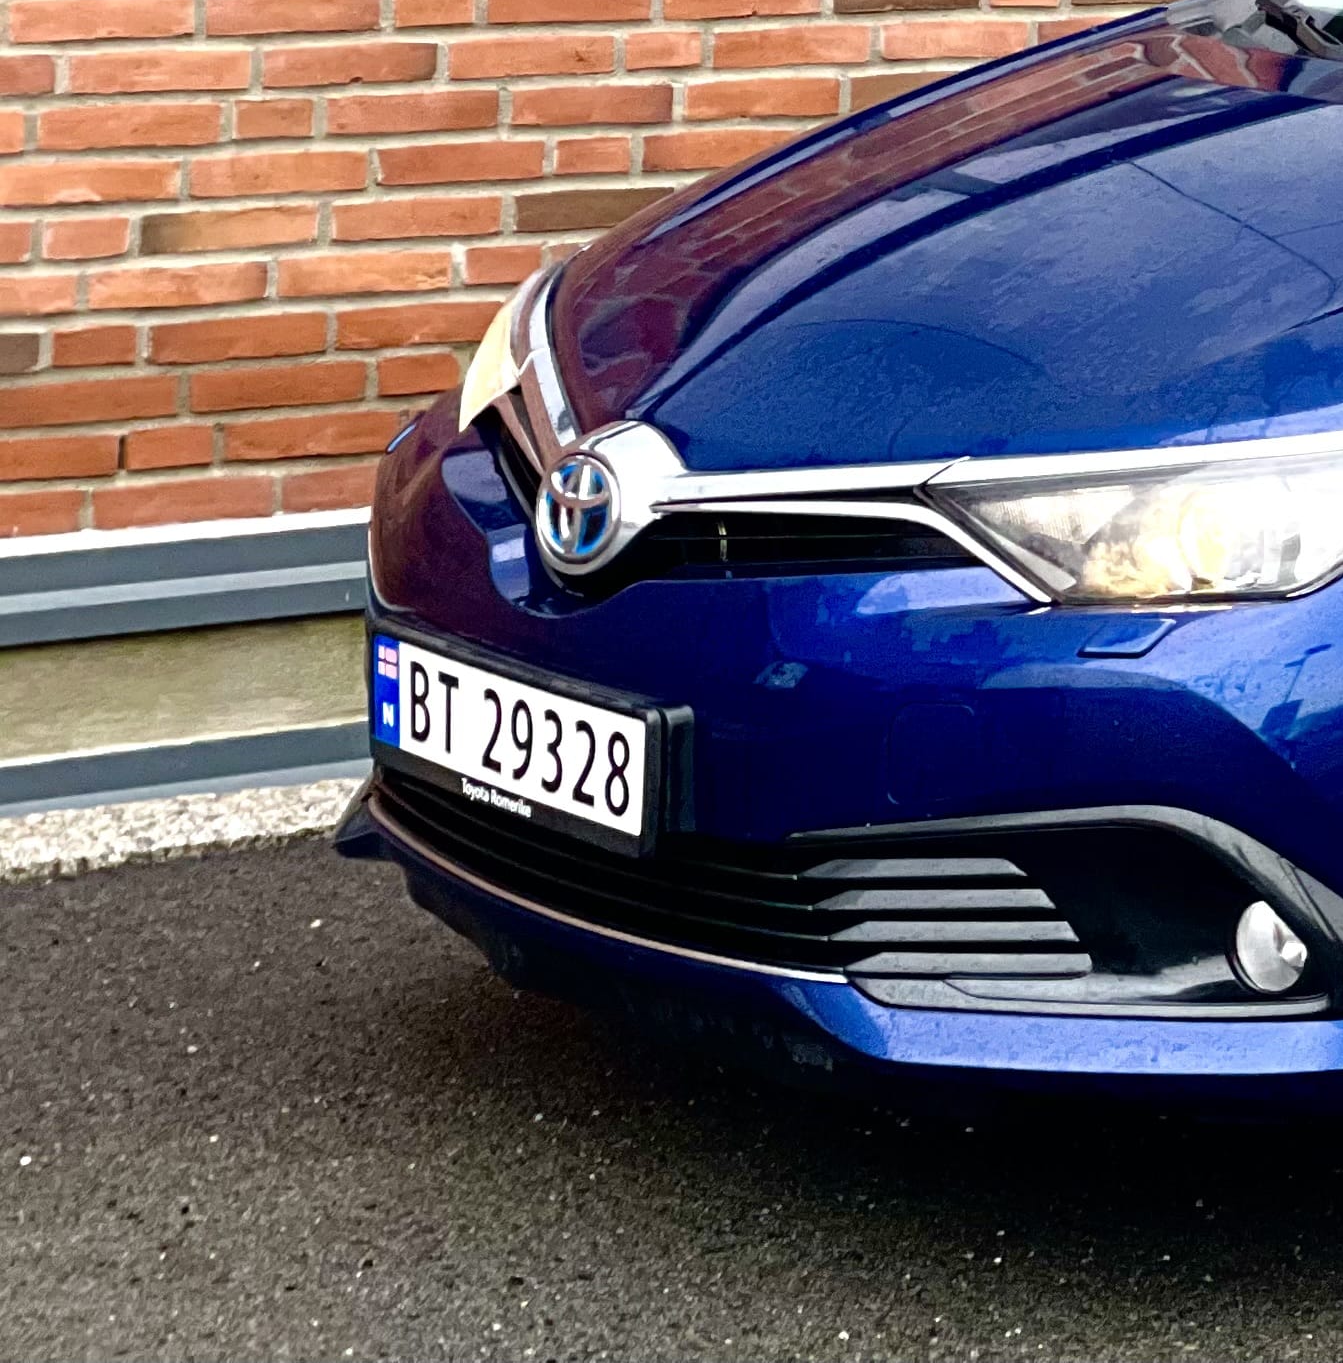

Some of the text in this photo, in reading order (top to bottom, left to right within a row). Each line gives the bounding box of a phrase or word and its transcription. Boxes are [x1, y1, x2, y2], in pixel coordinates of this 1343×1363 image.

[382, 702, 395, 728] N
[410, 661, 630, 817] BT 29328
[461, 777, 490, 802] Toyota
